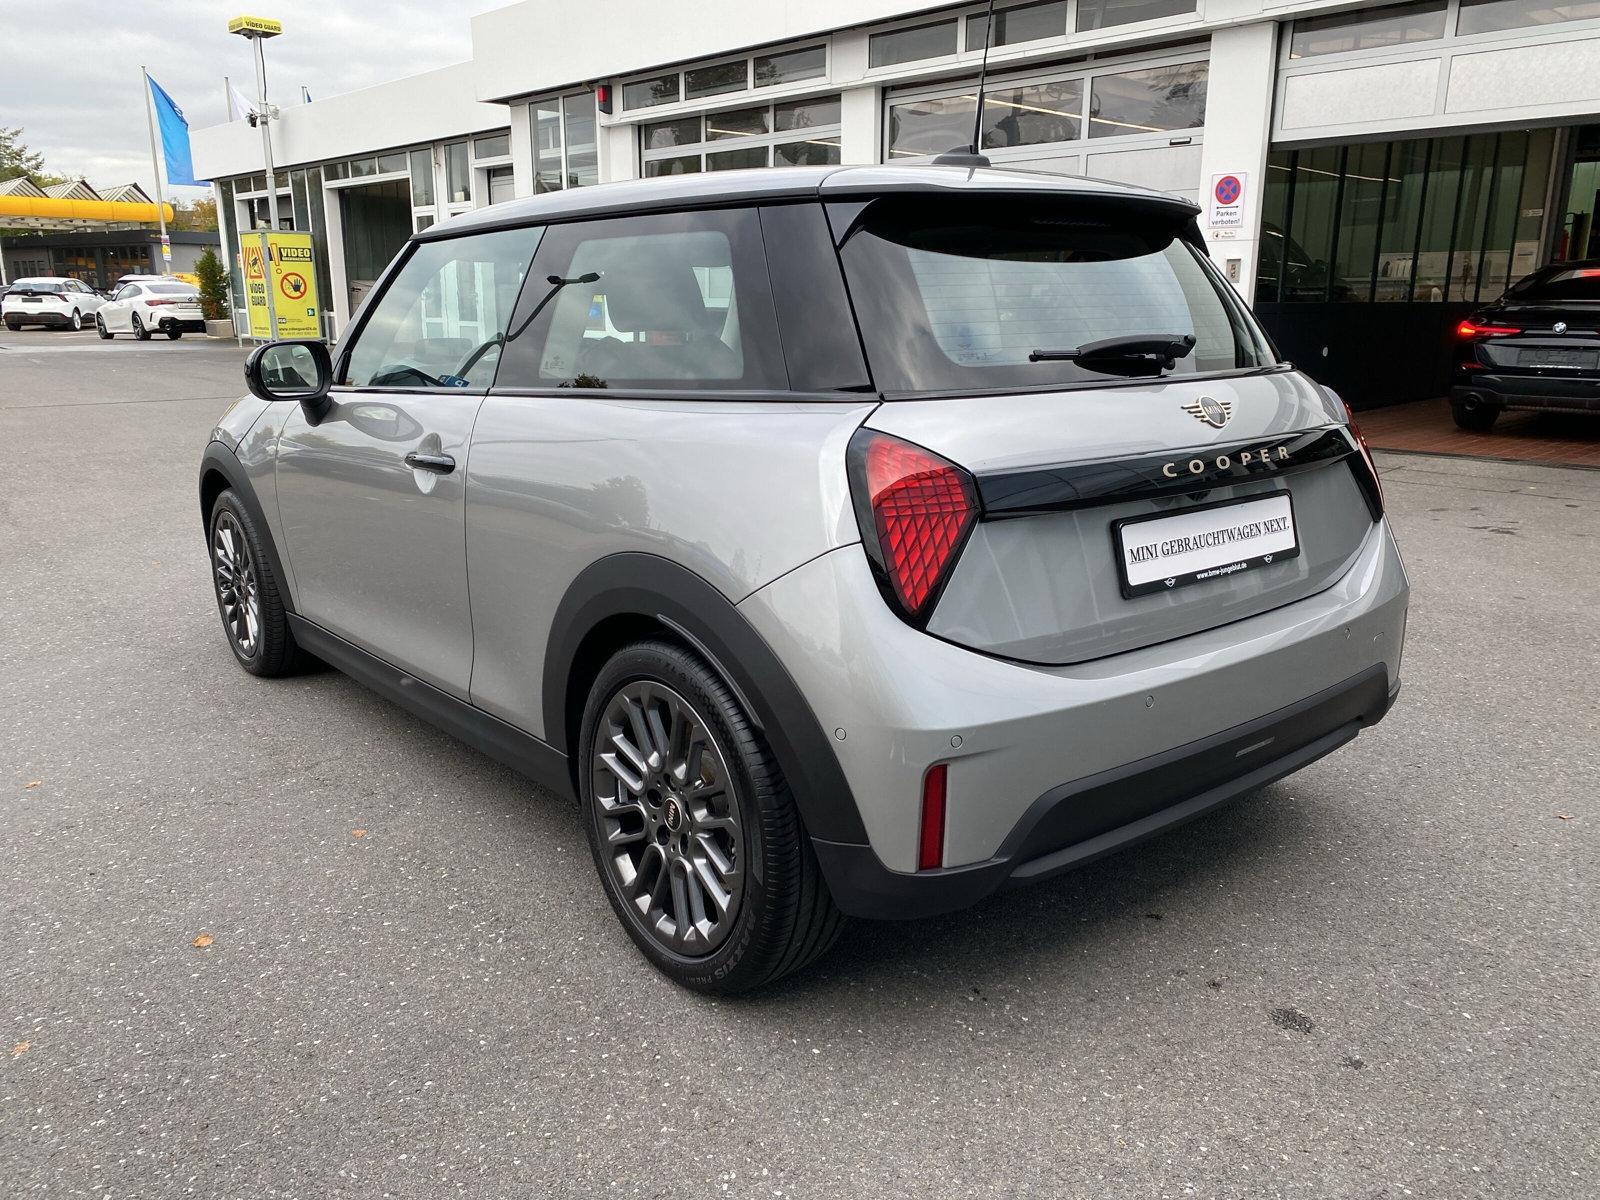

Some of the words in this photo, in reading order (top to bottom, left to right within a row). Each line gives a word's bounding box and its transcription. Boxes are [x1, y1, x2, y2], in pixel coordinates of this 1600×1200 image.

[281, 248, 310, 257] VIDEO
[1203, 405, 1222, 415] MINI
[1162, 446, 1290, 478] COOPER
[1129, 542, 1159, 563] MINI
[1161, 522, 1262, 556] GEBRAUCHTWAGEN
[1263, 516, 1290, 534] NEXT.
[668, 802, 676, 826] MINI
